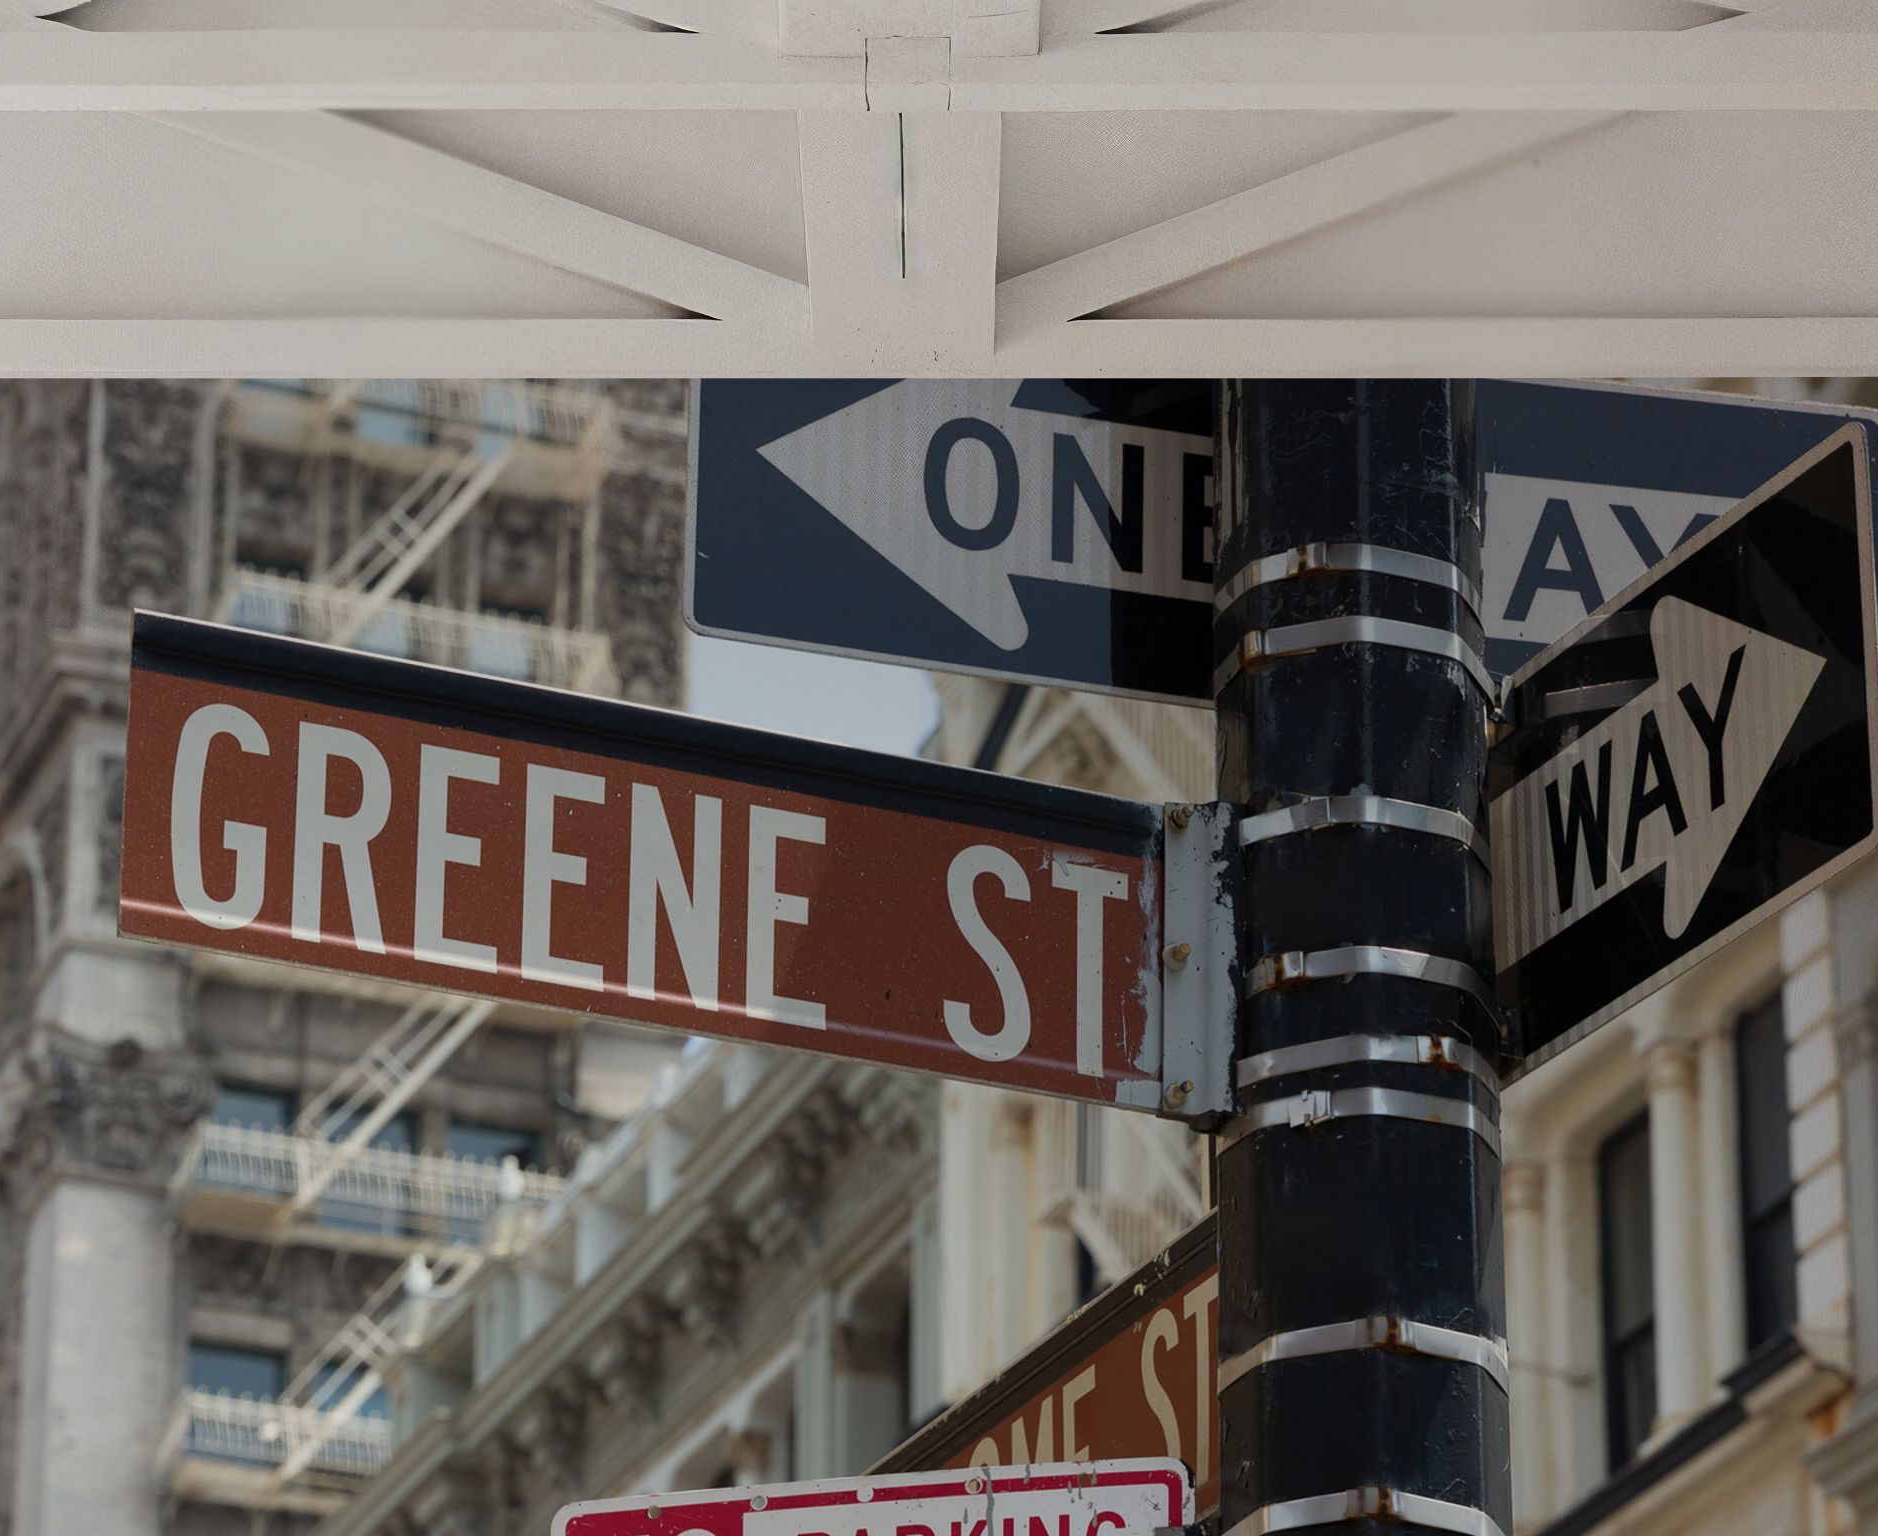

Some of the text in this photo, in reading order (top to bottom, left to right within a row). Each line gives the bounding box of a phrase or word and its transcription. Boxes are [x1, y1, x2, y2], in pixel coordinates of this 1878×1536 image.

[170, 703, 1130, 1079] GREENE ST
[1544, 642, 1748, 916] WAY
